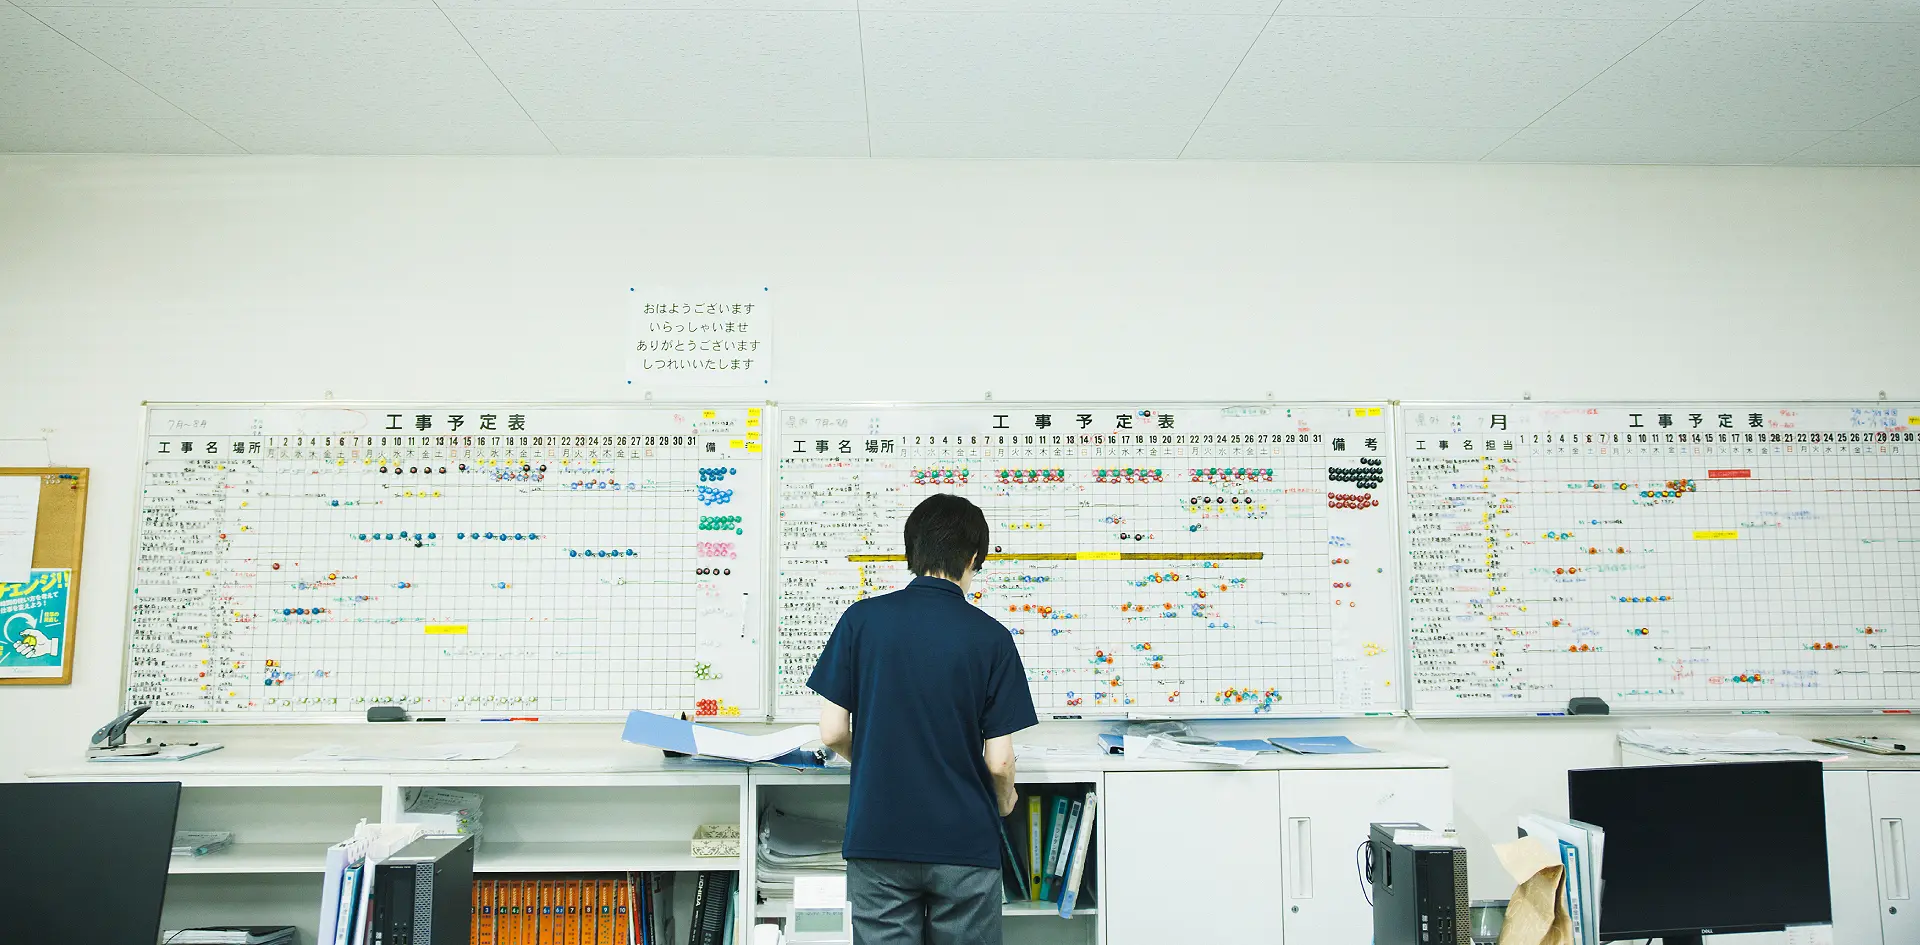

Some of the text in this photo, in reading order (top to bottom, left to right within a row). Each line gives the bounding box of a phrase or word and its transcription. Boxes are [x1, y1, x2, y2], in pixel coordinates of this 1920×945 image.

[643, 302, 755, 315] おはようございます
[649, 321, 749, 333] いらっしゃいませ
[636, 339, 761, 351] ありがとうございます
[643, 358, 755, 370] しつれいいたします
[385, 413, 526, 432] 工事予定表
[992, 413, 1175, 430] 工事予定表
[1490, 414, 1507, 431] 月
[1629, 412, 1764, 429] 工事予定表
[393, 436, 402, 446] 10
[408, 436, 415, 446] 11
[421, 436, 430, 446] 12
[435, 436, 445, 446] 13
[449, 436, 459, 446] 14
[463, 436, 472, 446] 15
[477, 436, 486, 446] 16
[491, 436, 500, 446] 17
[506, 436, 514, 446] 18
[519, 436, 528, 446] 19
[533, 436, 543, 446] 20
[547, 436, 556, 446] 21
[561, 436, 571, 446] 22
[575, 436, 585, 446] 23
[588, 436, 599, 446] 24
[602, 436, 613, 446] 25
[616, 436, 627, 446] 26
[630, 436, 641, 446] 27
[645, 436, 655, 446] 28
[659, 436, 669, 446] 29
[672, 436, 683, 446] 30
[687, 436, 697, 446] 31
[1024, 435, 1033, 445] 10
[1039, 435, 1046, 445] 11
[1052, 435, 1061, 445] 12
[1066, 435, 1075, 445] 13
[1079, 435, 1089, 445] 14
[1094, 435, 1103, 445] 15
[1108, 435, 1116, 444] 16
[1121, 435, 1131, 444] 17
[1135, 435, 1144, 444] 18
[1149, 435, 1158, 444] 19
[1162, 435, 1172, 444] 20
[1176, 435, 1185, 444] 21
[1189, 435, 1200, 444] 22
[1216, 435, 1227, 444] 24
[1230, 435, 1241, 444] 25
[1244, 435, 1255, 444] 26
[1258, 435, 1268, 444] 27
[1271, 434, 1282, 444] 28
[1285, 434, 1295, 444] 29
[1299, 434, 1309, 444] 30
[1313, 434, 1322, 444] 31
[1331, 437, 1378, 452] 備考
[1638, 434, 1647, 443] 10
[1652, 434, 1660, 443] 11
[1666, 434, 1674, 443] 12
[1678, 434, 1687, 443] 13
[1692, 433, 1701, 443] 14
[1705, 433, 1714, 443] 15
[1718, 433, 1727, 443] 16
[1731, 433, 1740, 443] 17
[1745, 433, 1753, 443] 18
[1758, 433, 1767, 443] 19
[1784, 433, 1794, 443] 21
[1797, 433, 1807, 443] 22
[1810, 433, 1821, 443] 23
[1823, 433, 1834, 443] 24
[1837, 433, 1847, 442] 25
[1850, 433, 1860, 442] 26
[1863, 433, 1874, 442] 27
[1877, 433, 1887, 442] 28
[1890, 433, 1900, 442] 29
[1903, 433, 1914, 442] 30
[158, 441, 218, 454] 工事名
[232, 441, 261, 454] 場所
[793, 439, 852, 454] 工事名
[865, 439, 894, 454] 場所
[1416, 439, 1473, 451] 工事名
[1486, 439, 1513, 451] 担当
